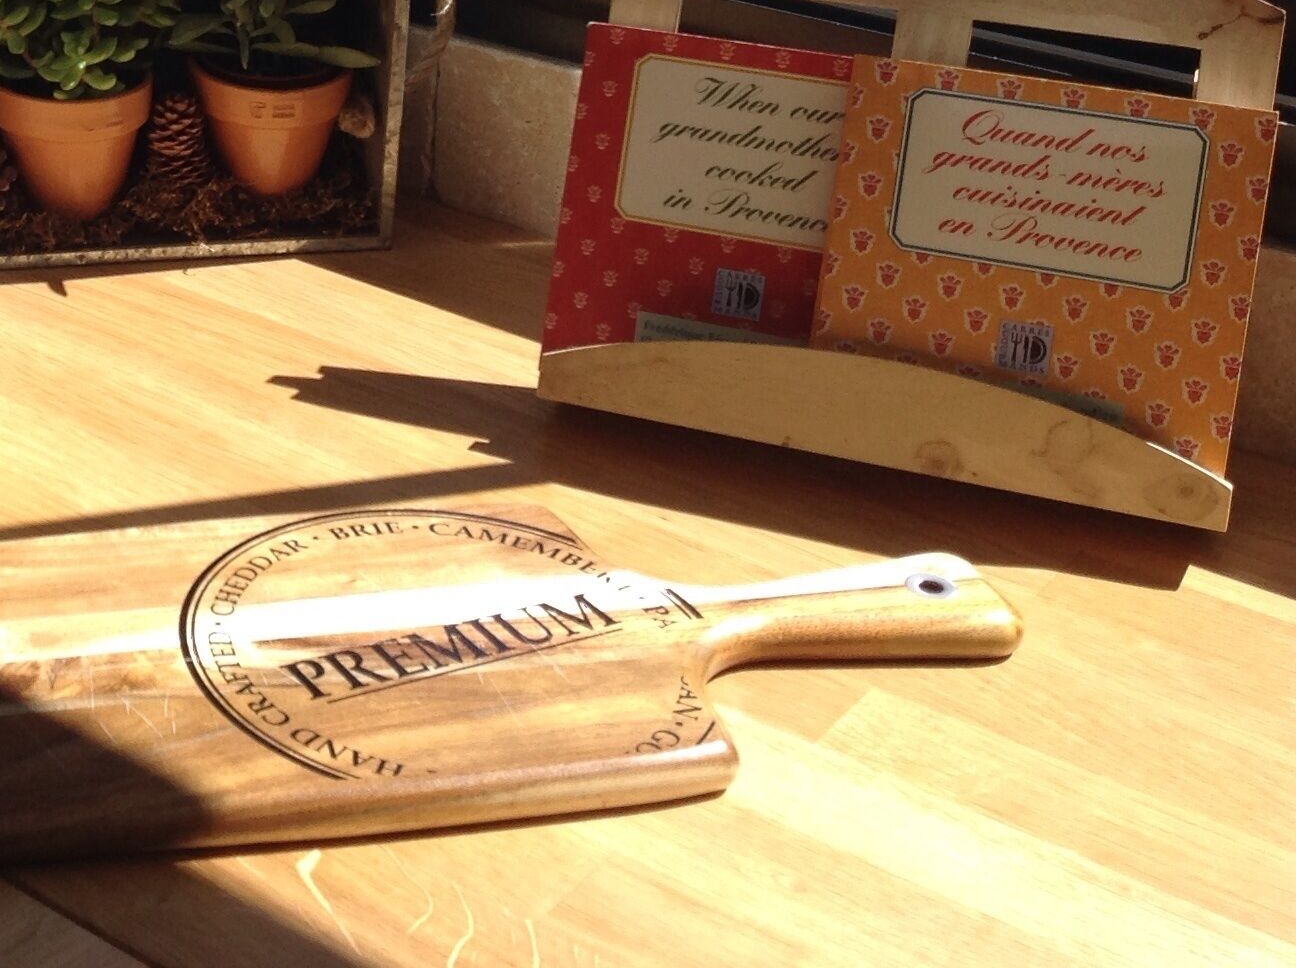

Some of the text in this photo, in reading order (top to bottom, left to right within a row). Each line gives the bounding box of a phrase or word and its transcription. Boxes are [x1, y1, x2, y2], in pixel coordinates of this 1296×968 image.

[695, 77, 845, 123] When our
[651, 123, 840, 162] grandmothe
[961, 108, 1148, 163] Quand nos
[705, 162, 819, 193] cooked
[662, 188, 828, 232] in Provenc
[952, 184, 1147, 227] cuisinaient
[938, 214, 1143, 264] en Provence
[210, 539, 309, 616] CHEDDAR
[329, 521, 404, 541] BRIE
[428, 522, 631, 591] CAMEMBE
[280, 593, 622, 700] PREMIUM
[208, 631, 404, 777] HAND CRAFTED
